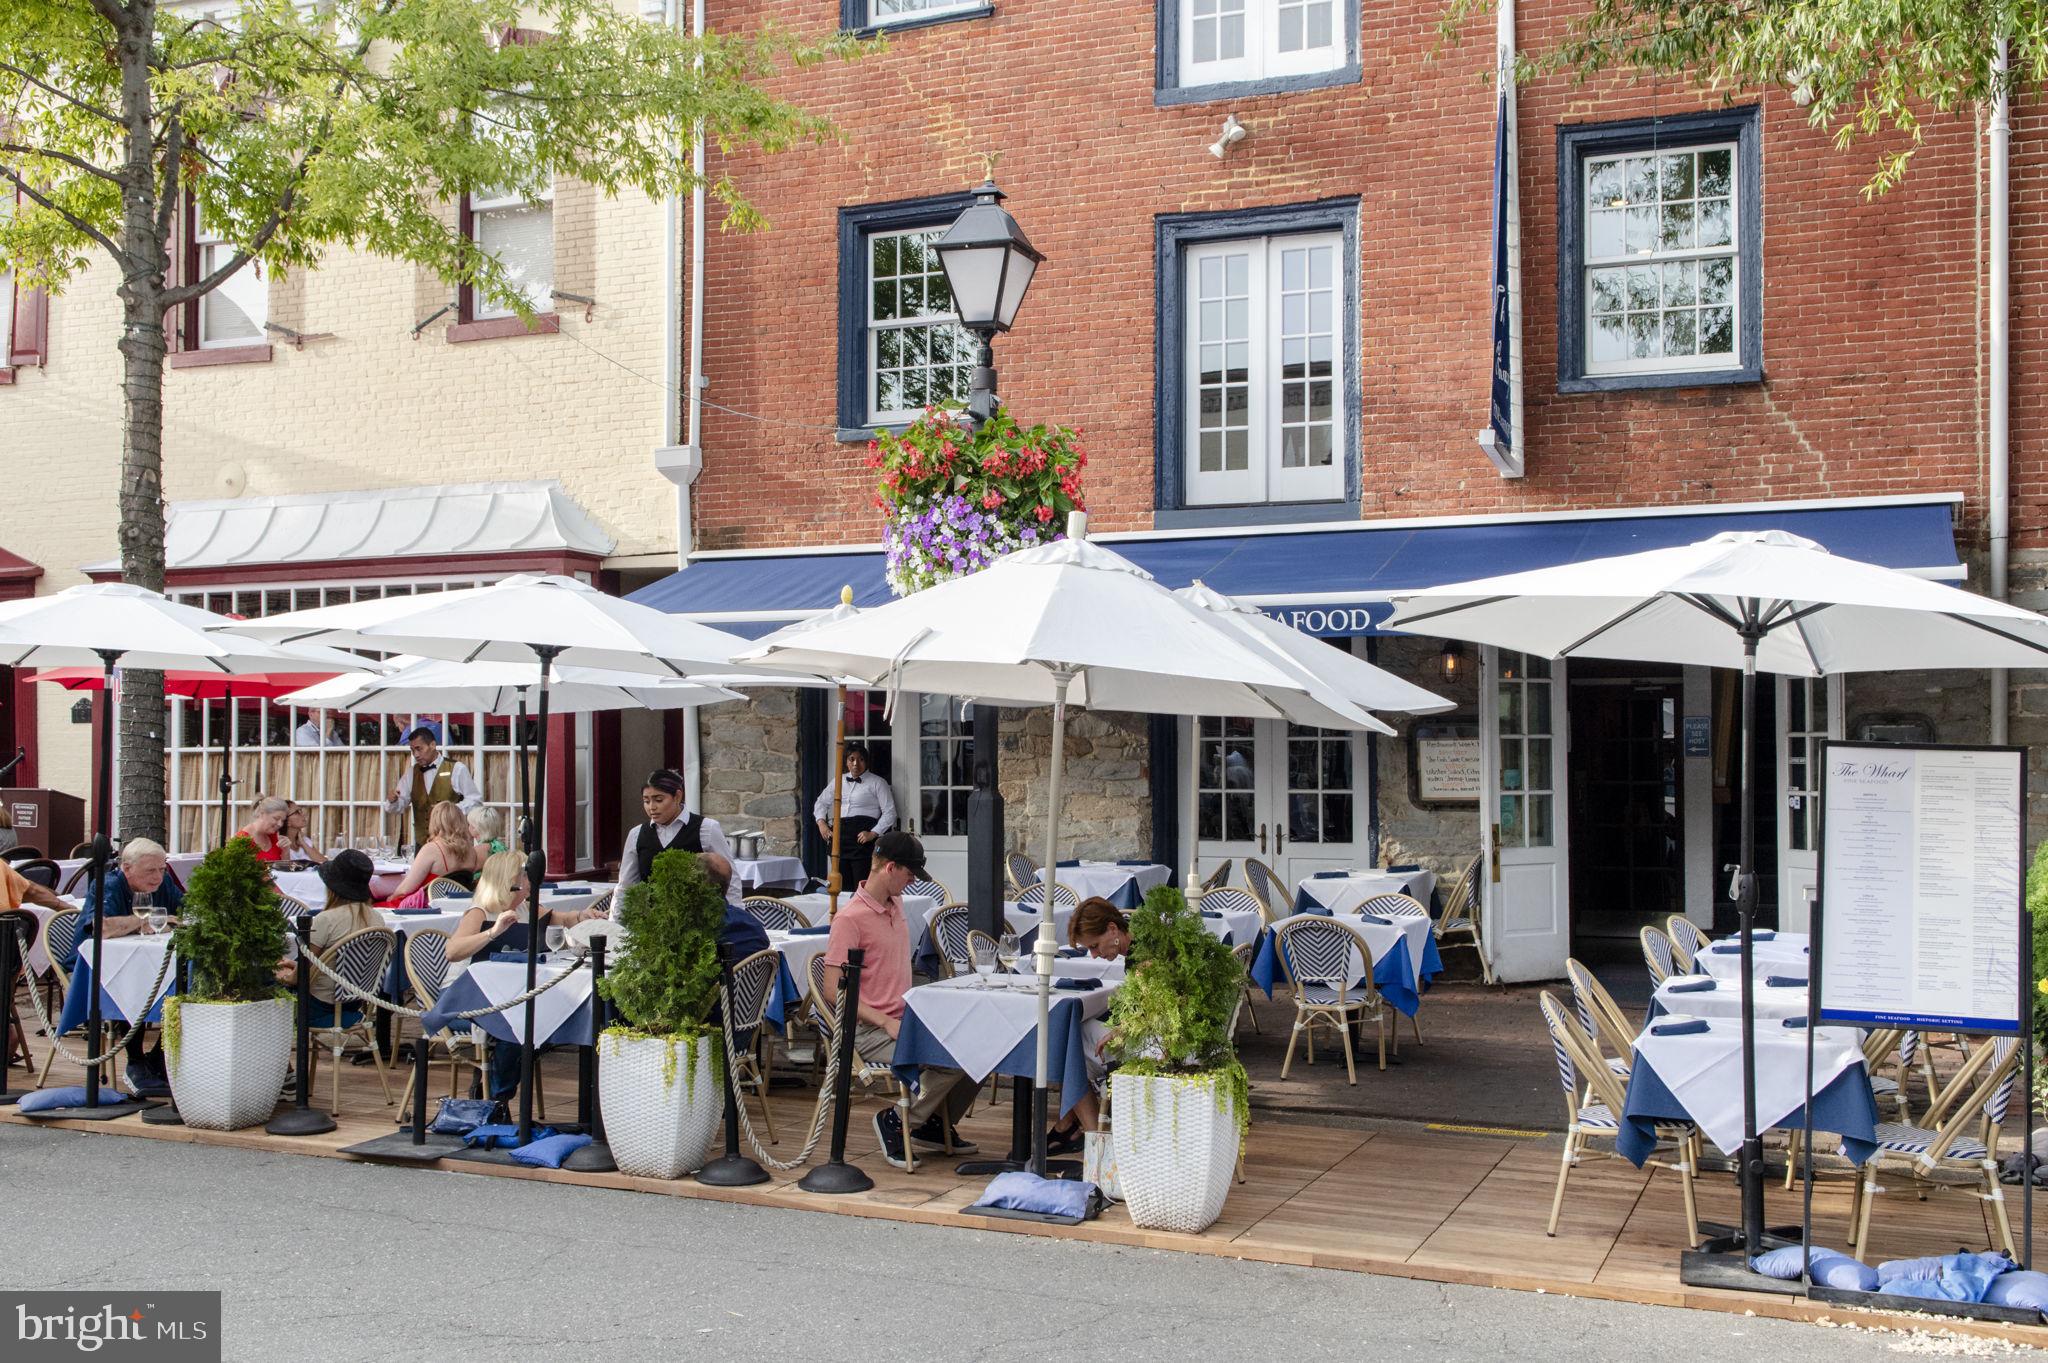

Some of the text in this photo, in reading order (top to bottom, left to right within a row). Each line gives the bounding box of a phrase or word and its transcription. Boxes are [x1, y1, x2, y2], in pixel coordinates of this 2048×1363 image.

[1261, 609, 1371, 632] AFOOD
[1832, 761, 1912, 782] The Wharf
